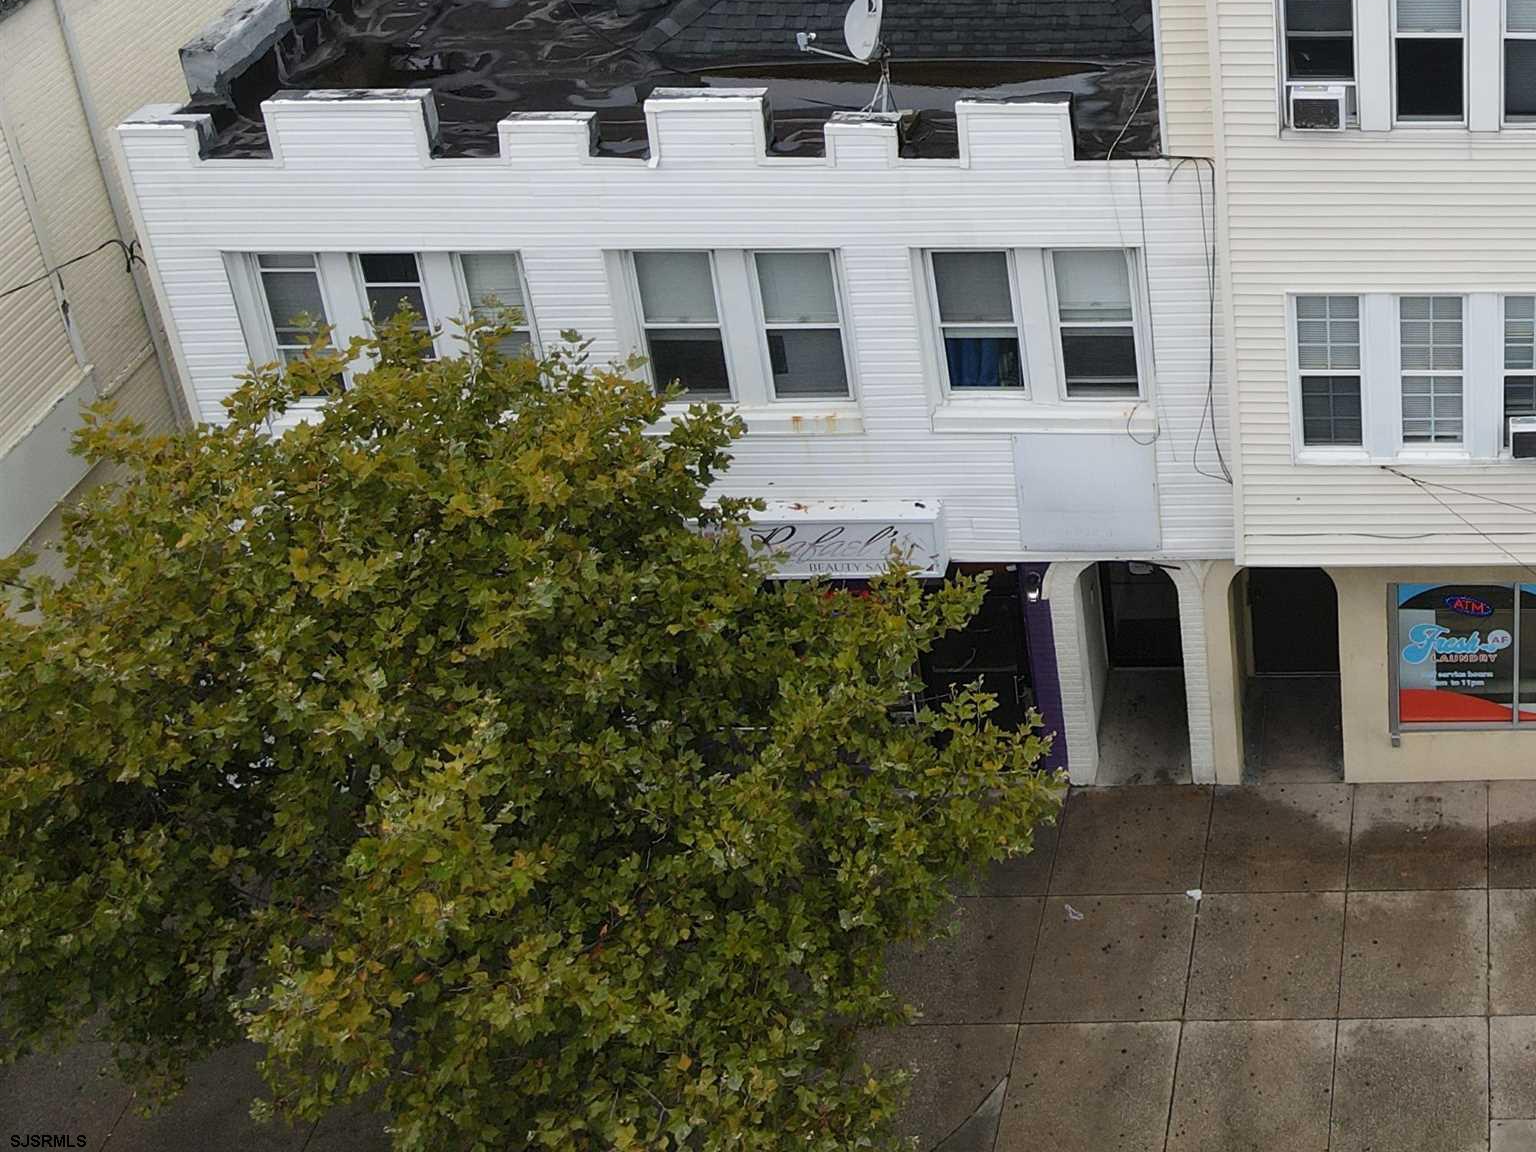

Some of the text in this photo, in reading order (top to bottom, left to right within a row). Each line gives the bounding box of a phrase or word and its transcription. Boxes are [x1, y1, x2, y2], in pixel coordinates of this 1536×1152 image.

[809, 562, 859, 572] BEAUTY
[1454, 599, 1486, 613] ATM
[1402, 623, 1481, 664] Fresh
[1492, 636, 1510, 645] AF
[1432, 653, 1498, 663] LAUNDRY
